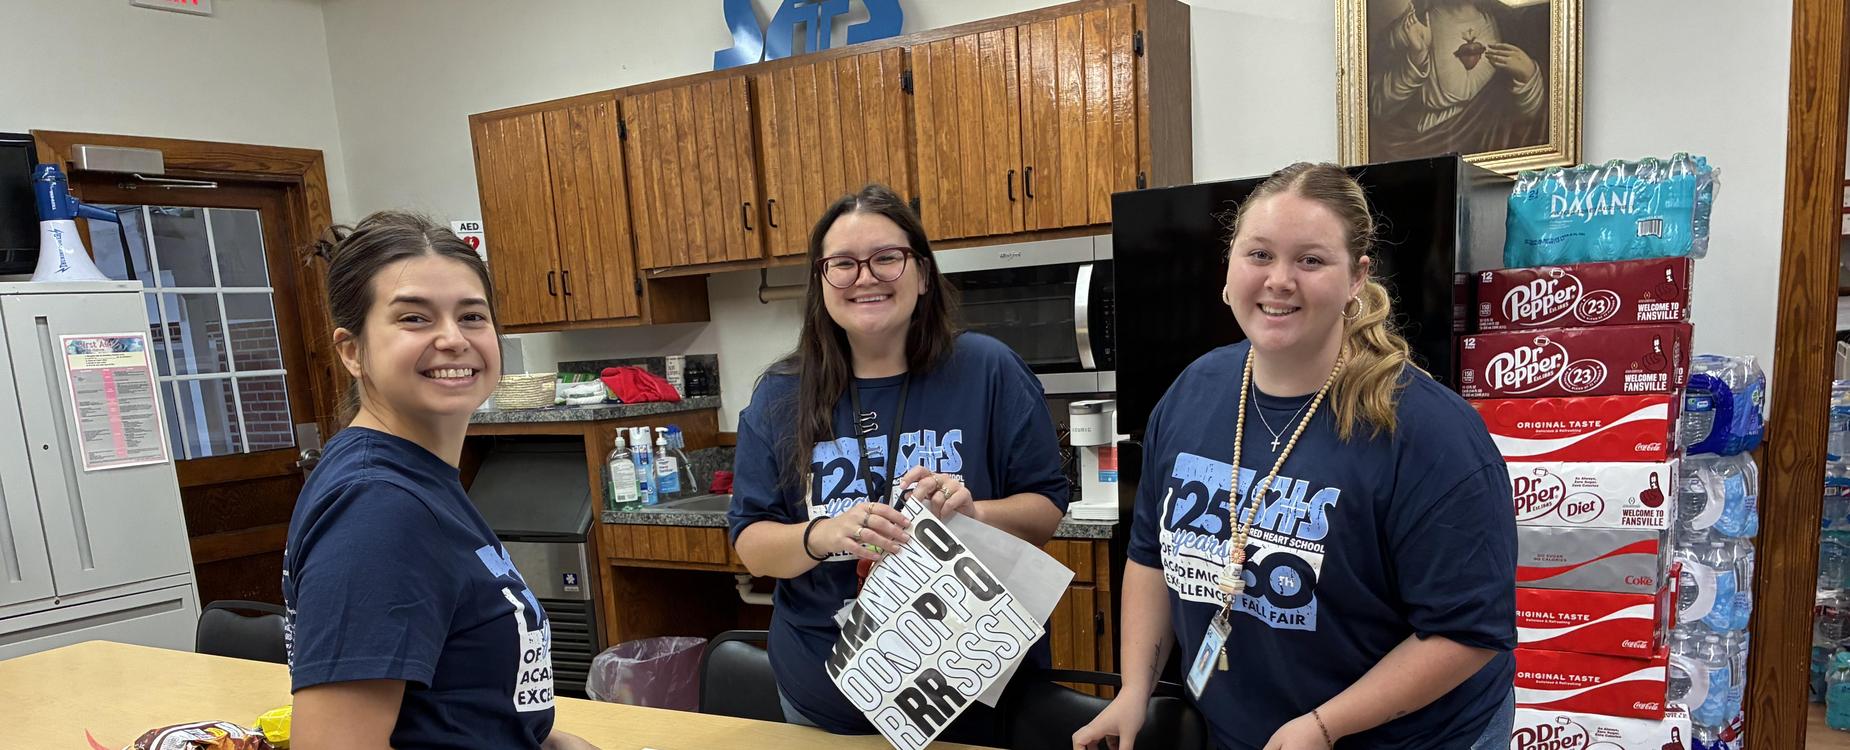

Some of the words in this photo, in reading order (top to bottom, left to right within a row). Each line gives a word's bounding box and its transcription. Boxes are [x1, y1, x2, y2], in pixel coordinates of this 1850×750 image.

[1551, 191, 1636, 223] DASANI
[460, 222, 480, 230] AED
[1530, 278, 1558, 300] Dr
[1503, 284, 1576, 322] Pepper
[1588, 299, 1605, 314] 23
[1638, 303, 1670, 312] WELCOME
[1637, 310, 1679, 321] FANSVILLE
[1514, 346, 1544, 369] Dr
[1487, 352, 1562, 390] Pepper
[1573, 368, 1592, 384] 23
[1624, 374, 1658, 382] WELCOME
[1659, 373, 1668, 381] TO
[1624, 382, 1667, 392] FANSVILLE
[1514, 476, 1542, 498] Dr
[1168, 477, 1244, 540] 125
[1240, 475, 1341, 541] SHS
[1514, 484, 1560, 516] pper
[1567, 500, 1596, 517] Diet
[1622, 509, 1654, 518] WELCOME
[1656, 510, 1664, 518] TO
[1622, 518, 1664, 527] FANSVILLE
[1162, 542, 1172, 556] OF
[1173, 528, 1230, 557] years
[1263, 531, 1290, 544] HEART
[1290, 538, 1325, 554] SCHOOL
[1624, 575, 1653, 586] Coke
[1242, 598, 1266, 618] FALL
[1270, 611, 1306, 625] FAIR
[1516, 610, 1555, 619] RIGINAL
[1558, 613, 1590, 621] TASTE
[524, 647, 542, 664] OF
[1518, 672, 1565, 680] ORIGINAL
[1569, 674, 1600, 683] TASTE
[1536, 724, 1564, 743] Dr
